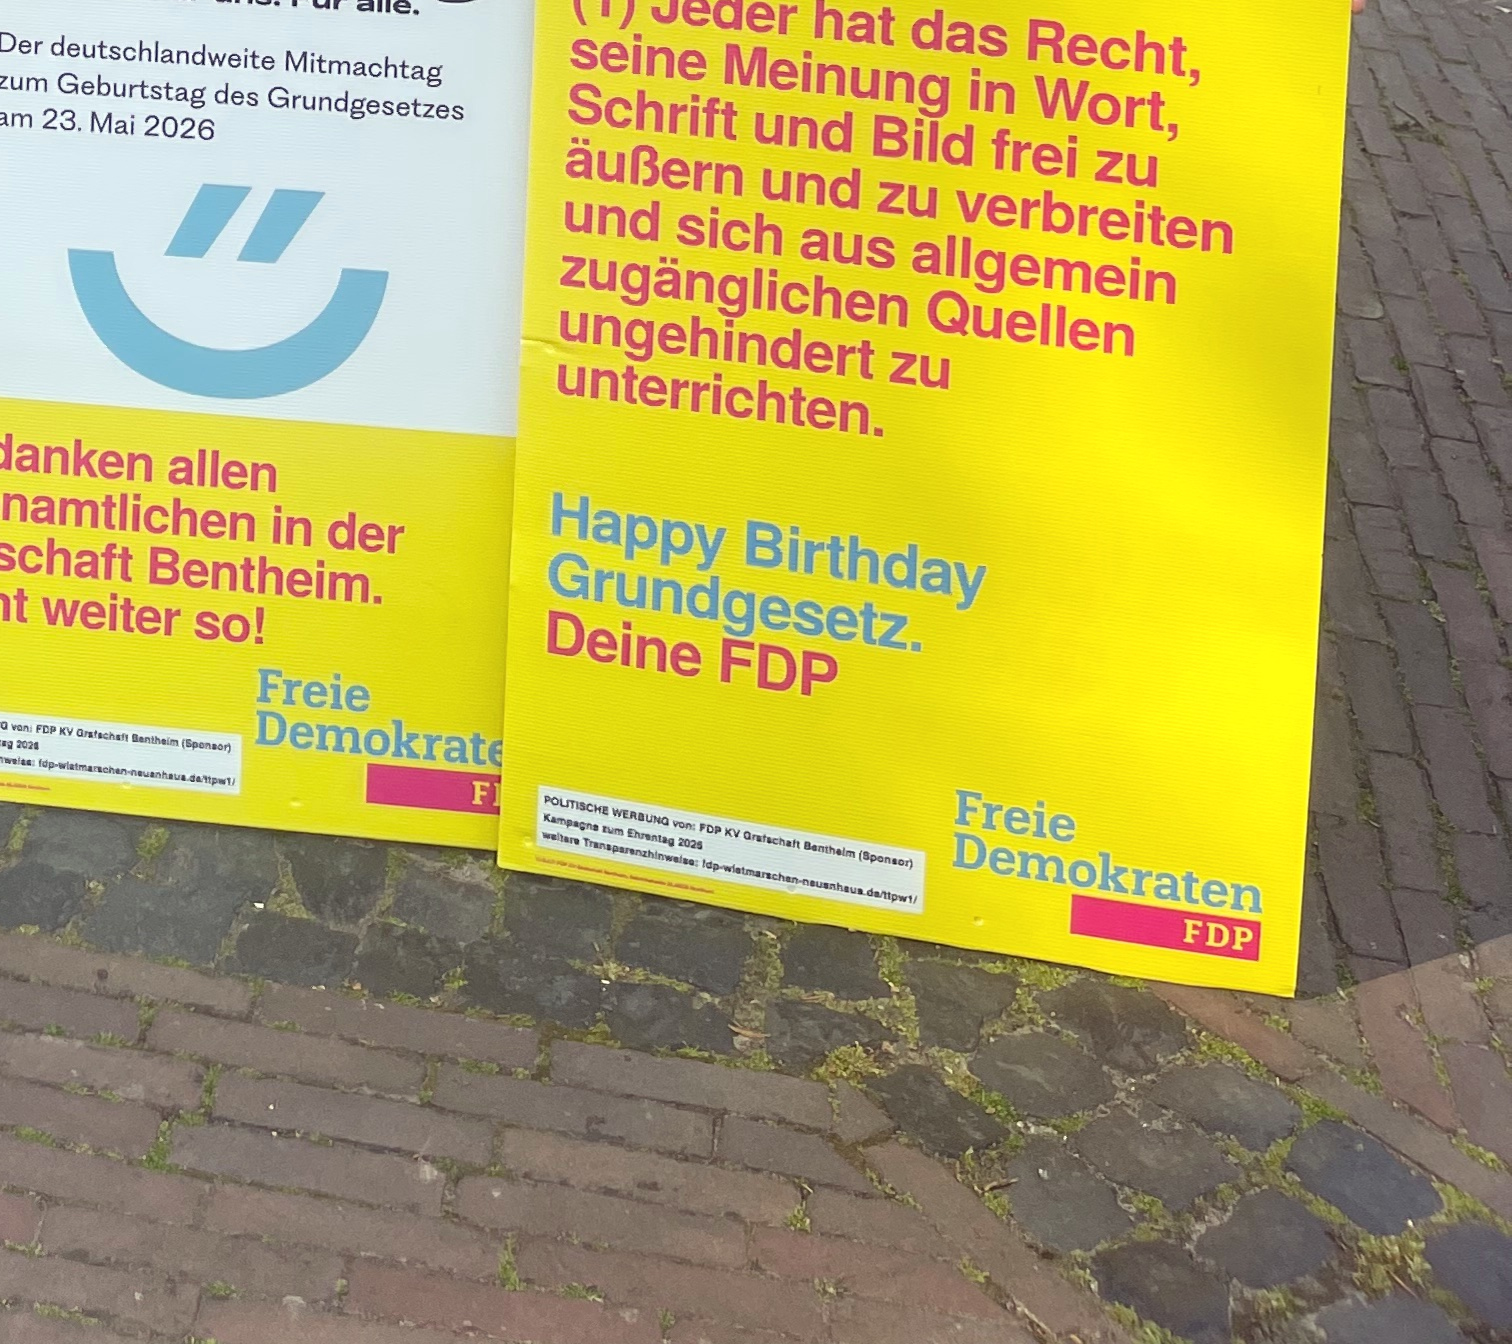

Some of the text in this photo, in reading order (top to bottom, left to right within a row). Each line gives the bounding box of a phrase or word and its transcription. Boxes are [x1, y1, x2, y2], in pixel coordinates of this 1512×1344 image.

[51, 35, 275, 70] deutschlandweite
[286, 51, 442, 87] Mitmachtag
[911, 9, 1008, 57] das
[1027, 18, 1200, 86] Recht,
[58, 73, 206, 109] Geburtstag
[215, 83, 258, 106] des
[268, 87, 463, 120] Grundgesetzes
[571, 33, 1178, 141] seine Meinung in Wort,
[42, 109, 82, 133] 23.
[91, 112, 134, 135] Mai
[145, 115, 214, 140] 2026
[568, 82, 1158, 188] Schrift und Bild frei zu
[565, 137, 1233, 254] äußern und zu verbreiten
[565, 201, 1176, 304] und sich aus allgemein
[560, 255, 1134, 357] zugänglichen Quellen
[560, 310, 950, 389] ungehindert zu
[557, 364, 883, 436] unterrichten.
[168, 448, 277, 492] allen
[272, 505, 312, 546] in
[327, 512, 405, 554] der
[149, 546, 382, 604] Bentheim.
[42, 592, 181, 636] weiter
[195, 607, 264, 644] so!
[542, 831, 580, 847] weitere
[543, 812, 599, 832] Kampagne
[602, 826, 624, 837] zum
[627, 828, 676, 848] Ehrentag
[543, 795, 609, 816] POLITISCHE
[612, 807, 670, 827] WERBUNG
[699, 822, 722, 836] FDP
[724, 827, 741, 839] KV
[743, 830, 801, 850] Grafschaft
[803, 840, 856, 860] Bentheim
[858, 849, 914, 870] (Sponsor)
